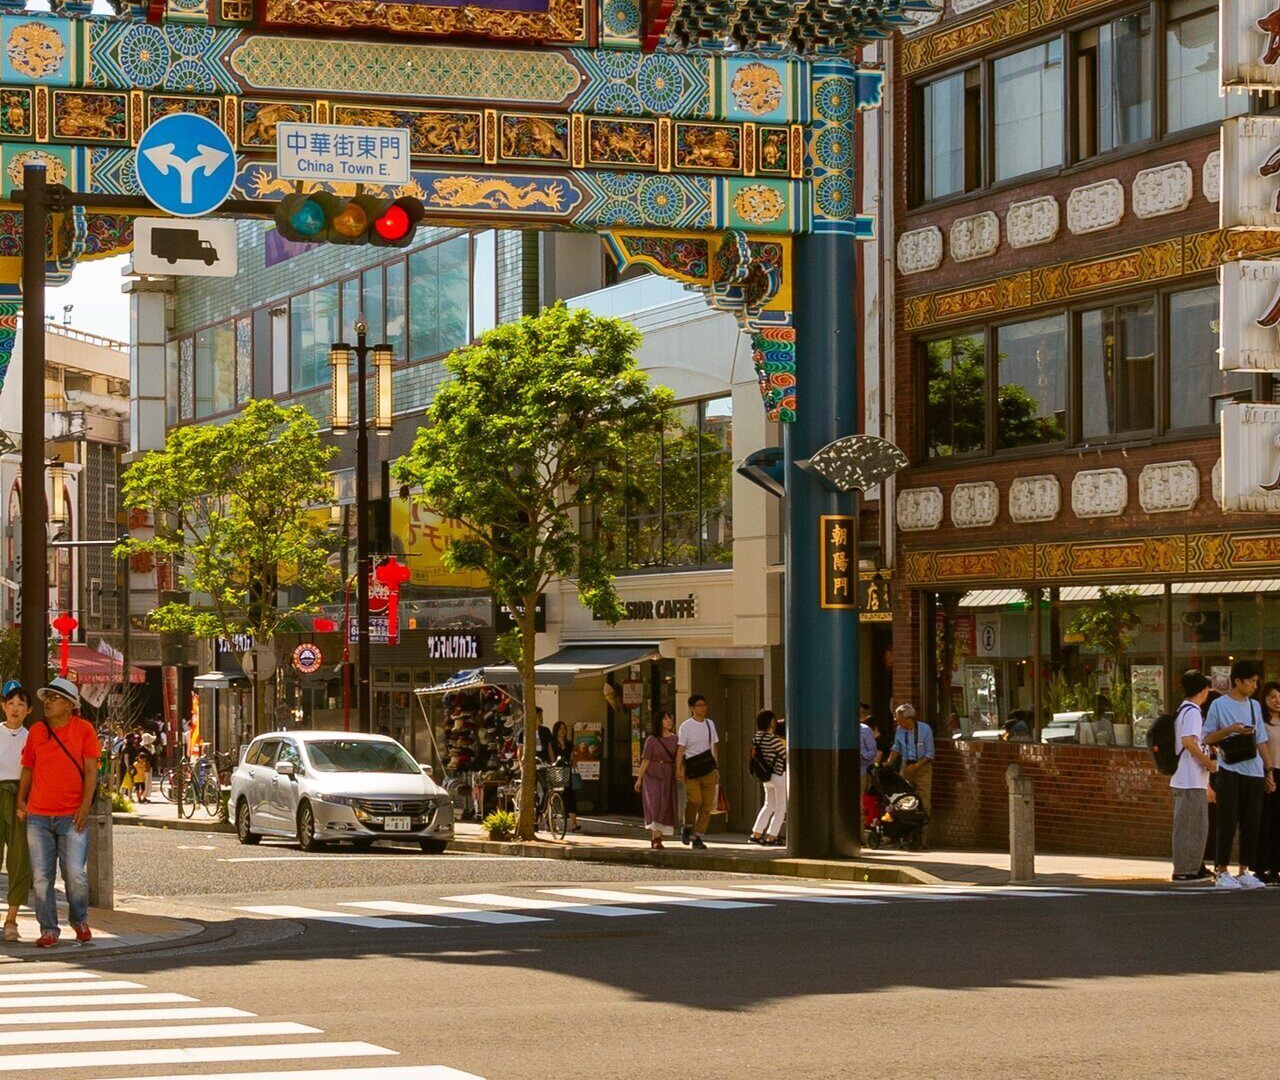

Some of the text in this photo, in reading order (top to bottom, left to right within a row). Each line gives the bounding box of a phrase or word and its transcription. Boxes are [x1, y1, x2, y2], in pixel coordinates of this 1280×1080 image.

[286, 130, 401, 161] 中華街東門
[297, 159, 391, 176] China Town E.
[831, 524, 848, 597] 朝陽門
[428, 636, 478, 659] サンマルクカフェ
